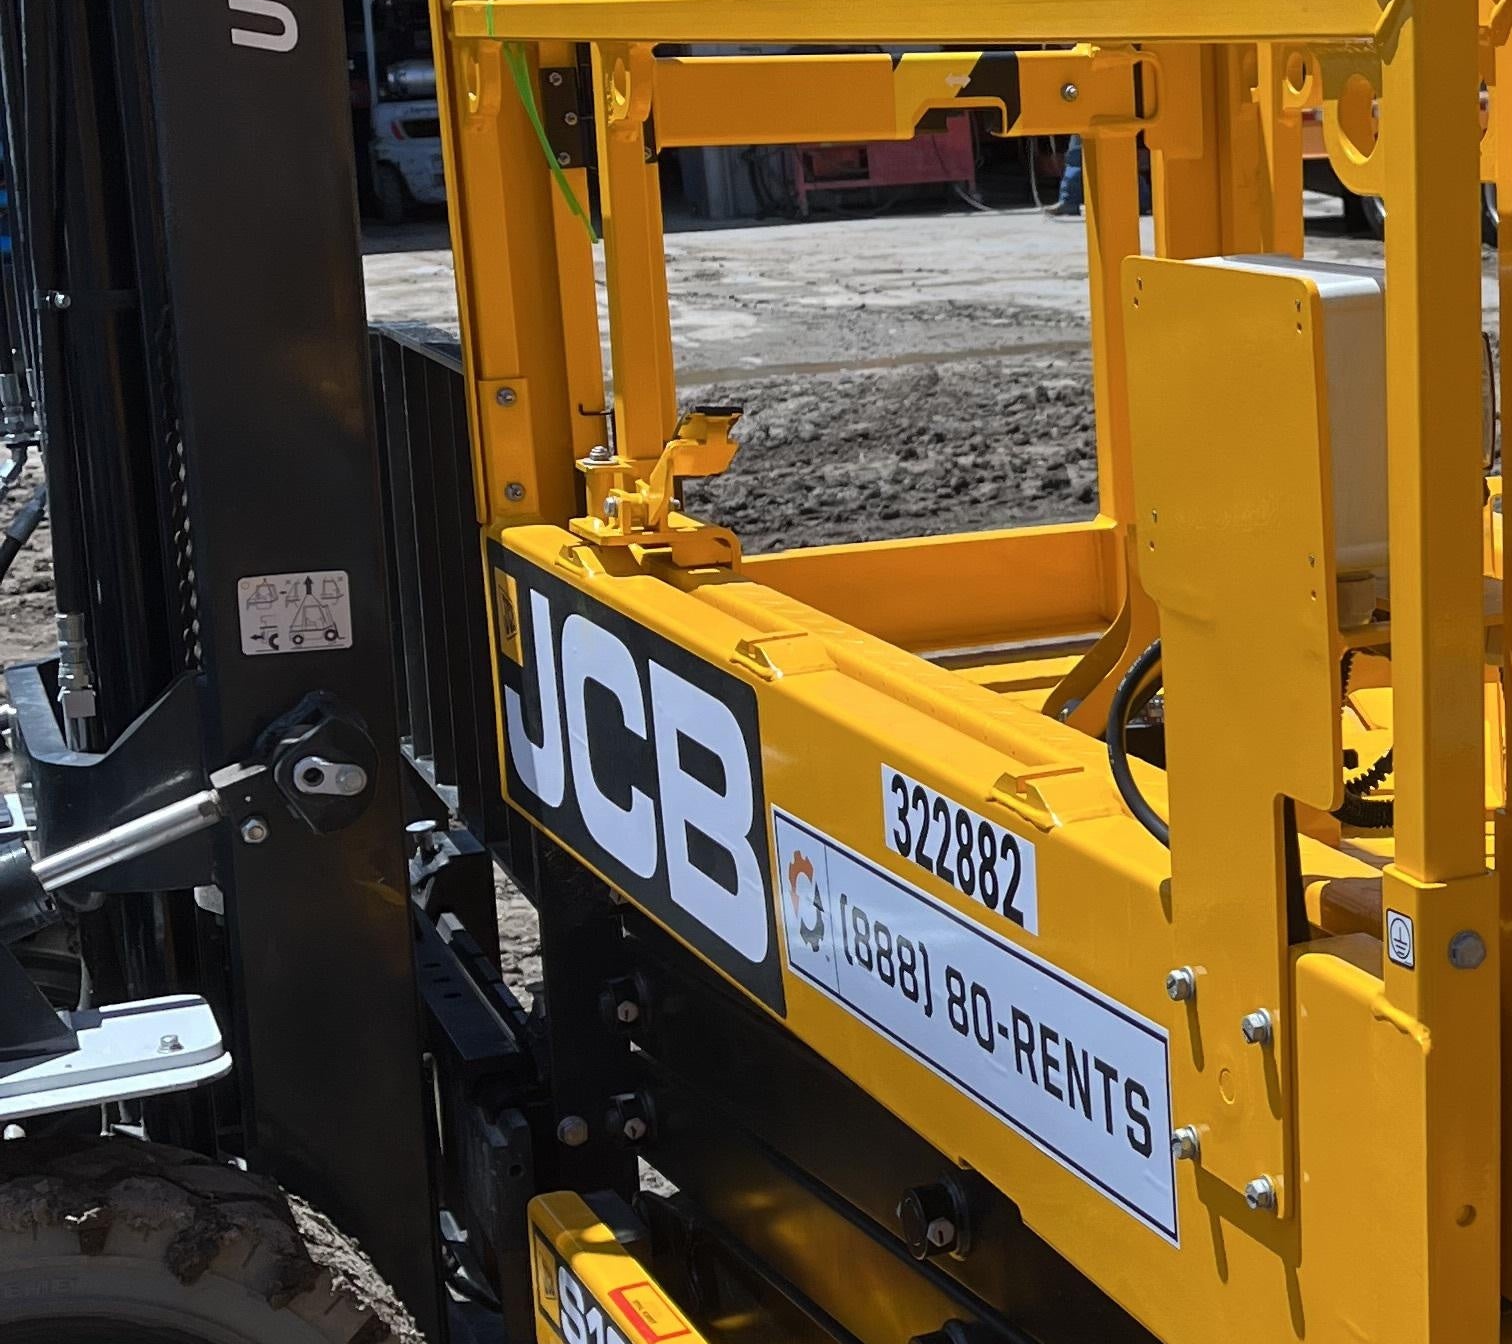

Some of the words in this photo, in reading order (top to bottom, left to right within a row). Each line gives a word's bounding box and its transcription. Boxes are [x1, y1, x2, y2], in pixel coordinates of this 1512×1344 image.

[505, 587, 768, 964] JCB
[891, 772, 1026, 928] 322882
[841, 892, 930, 1018] (888)
[947, 972, 1153, 1159] 80-RENTS
